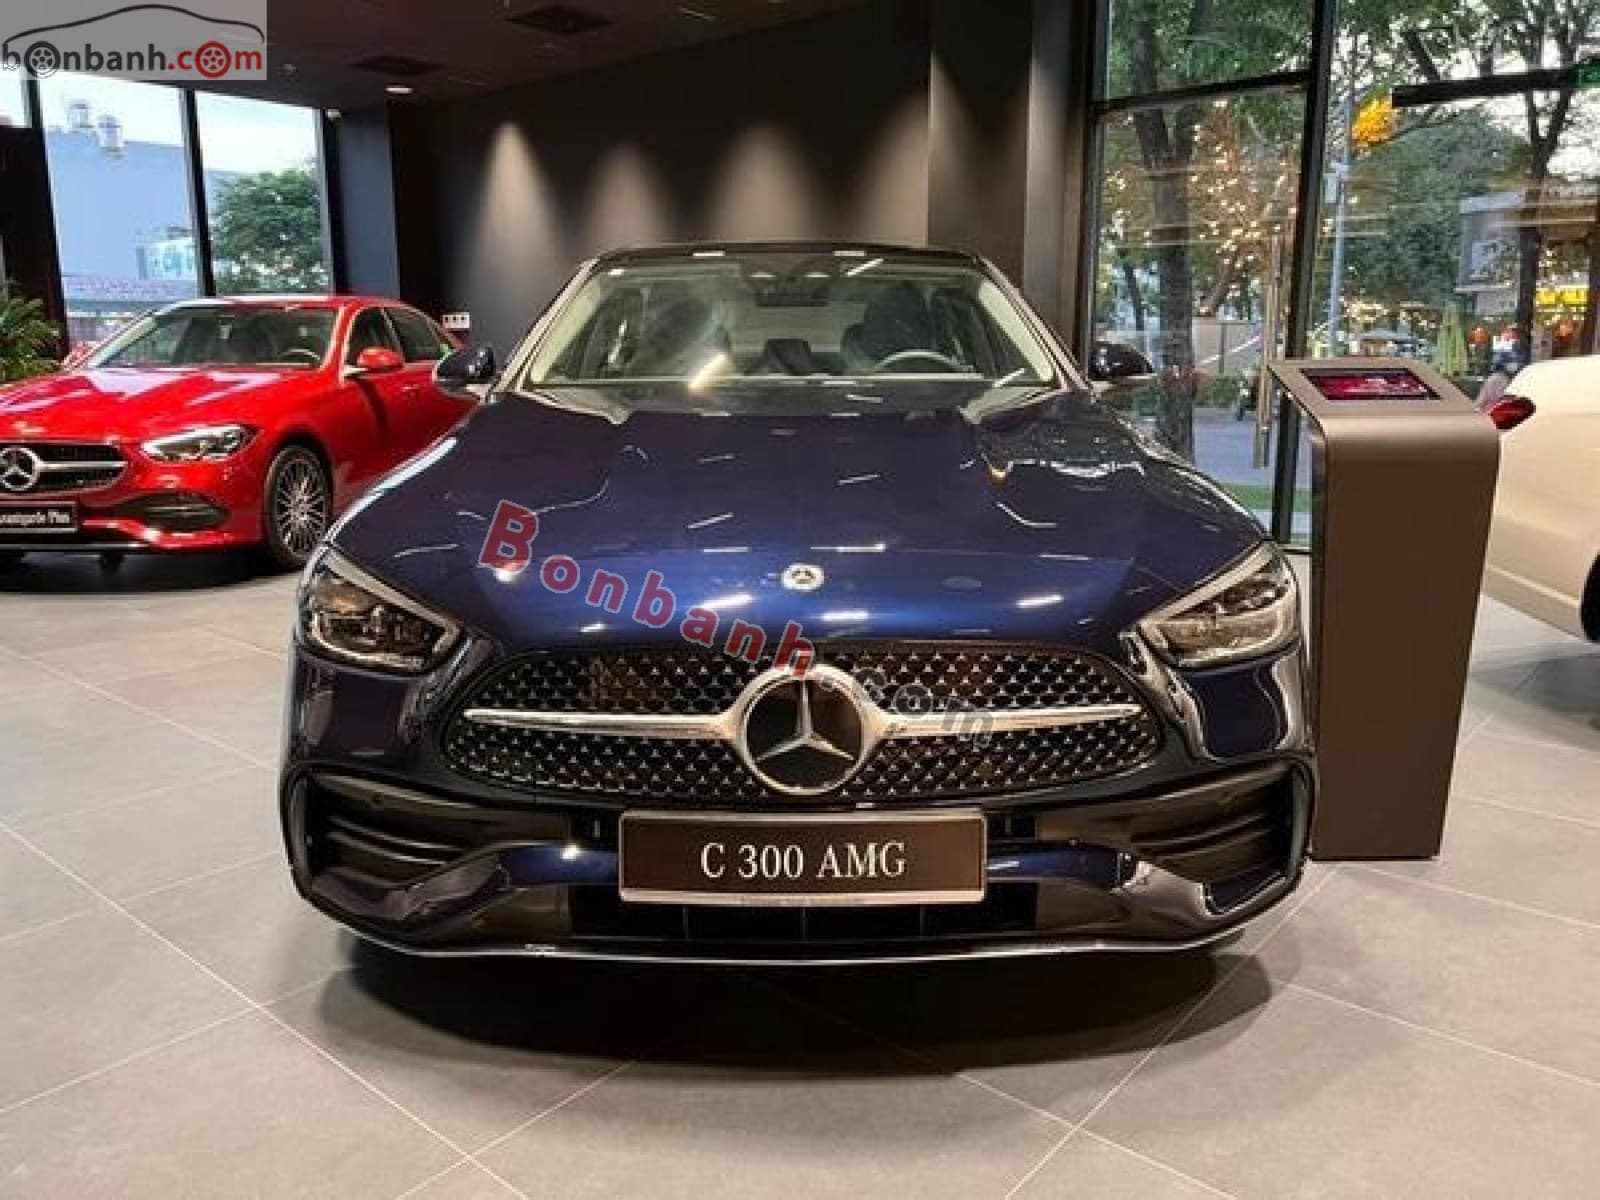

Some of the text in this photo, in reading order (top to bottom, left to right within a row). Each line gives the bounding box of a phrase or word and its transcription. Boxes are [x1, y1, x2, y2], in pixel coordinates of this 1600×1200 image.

[700, 841, 905, 878] C 300 AMG
